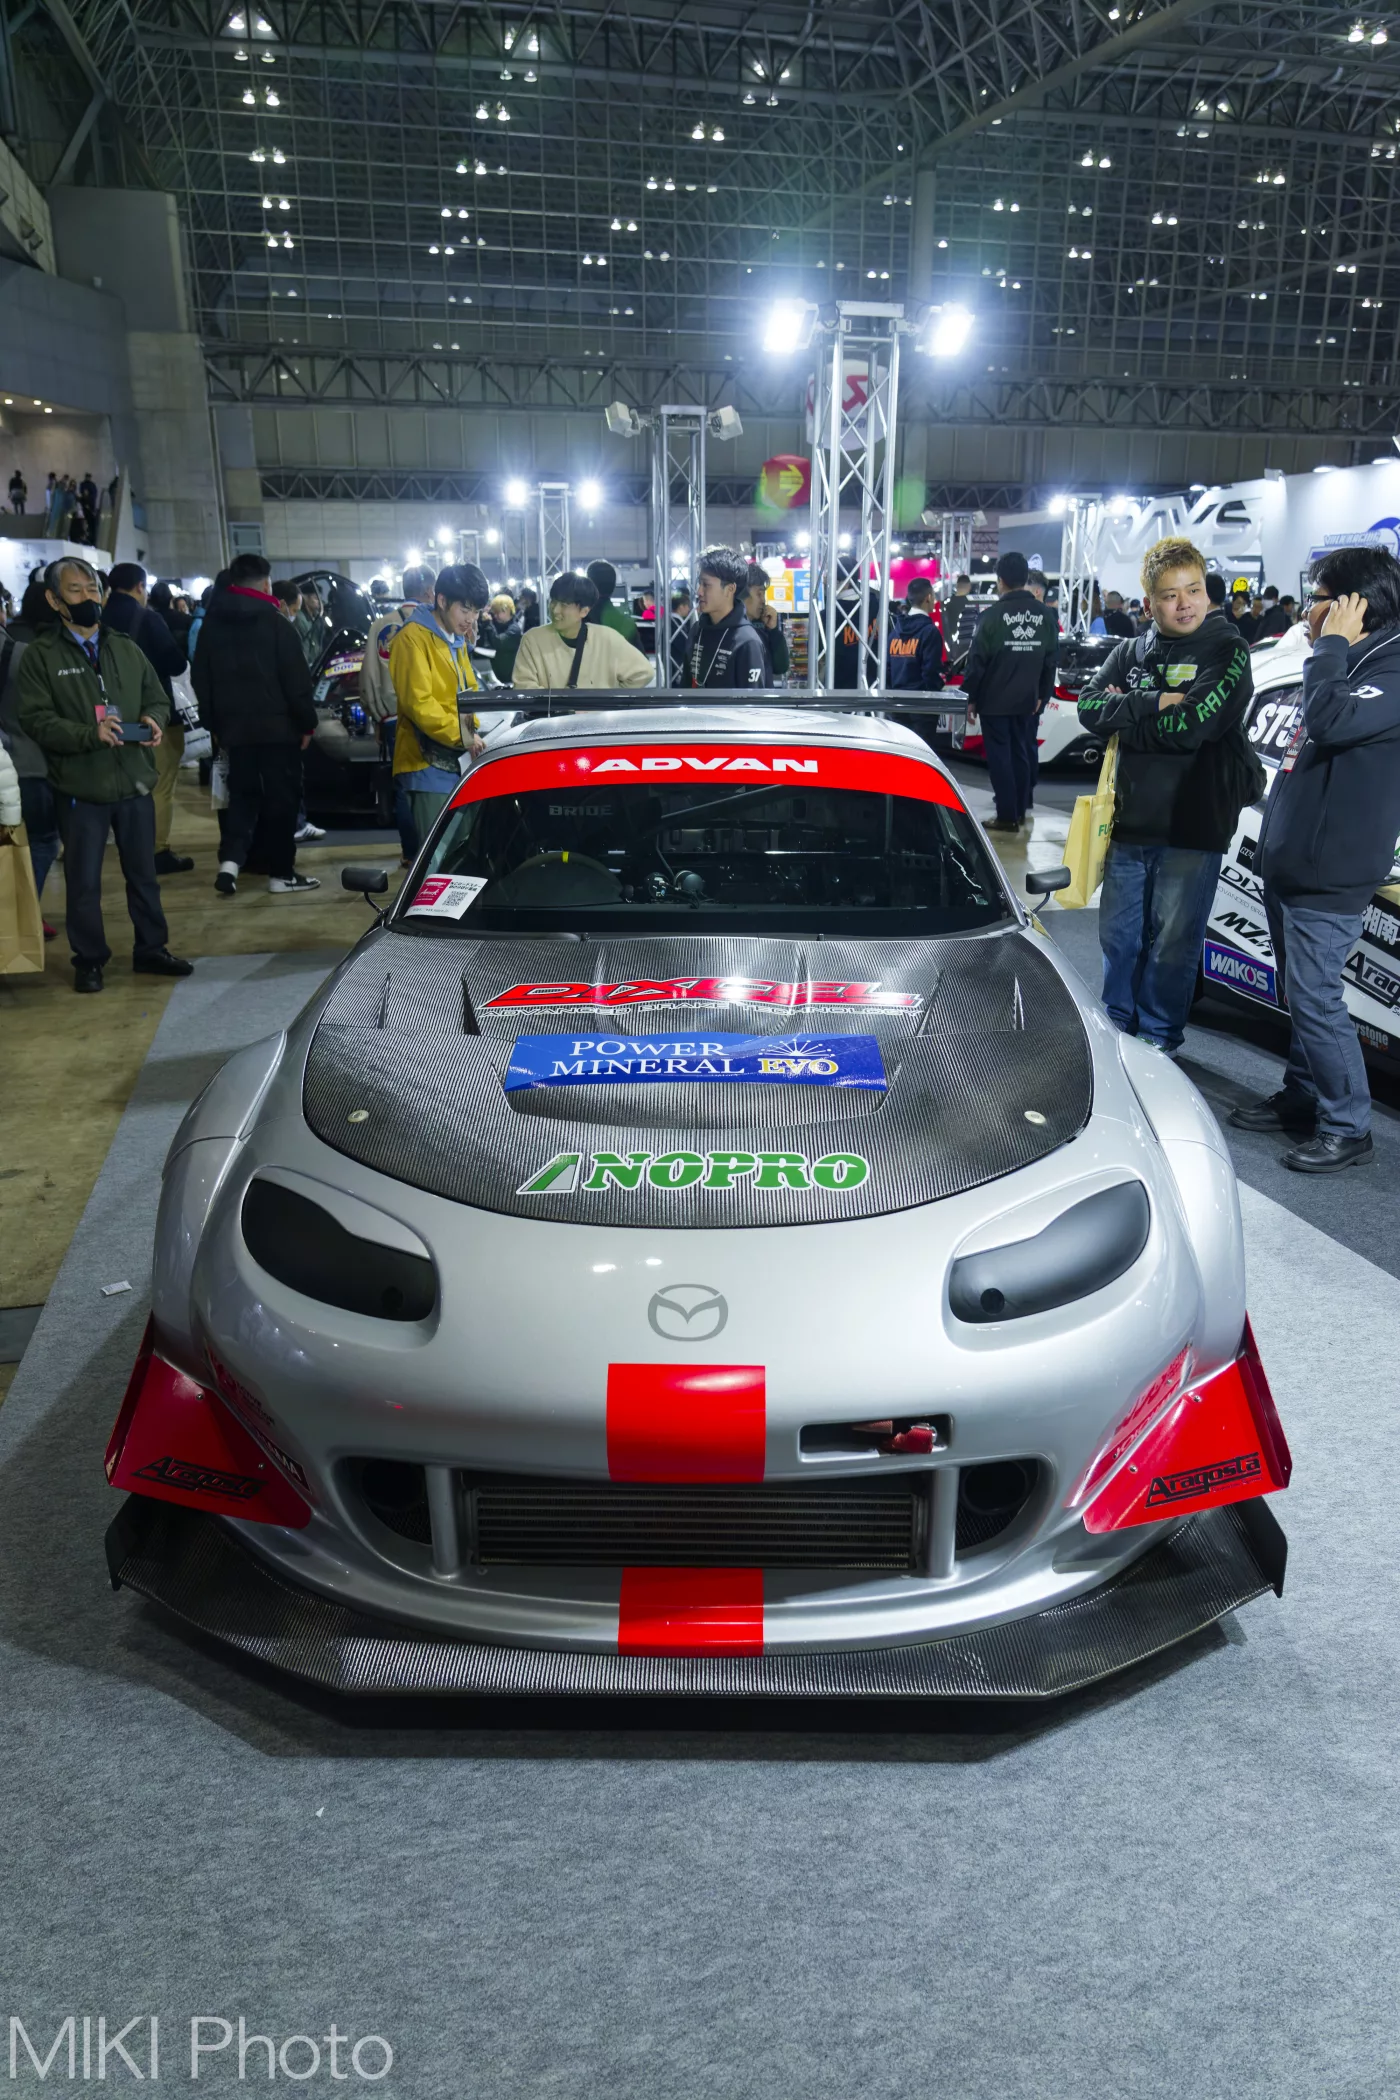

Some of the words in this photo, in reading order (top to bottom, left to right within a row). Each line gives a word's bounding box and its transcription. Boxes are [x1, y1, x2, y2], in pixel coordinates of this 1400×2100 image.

[1099, 491, 1264, 565] RAYS
[748, 668, 762, 683] 37
[1195, 647, 1248, 723] RACING
[591, 757, 819, 774] ADVAN
[549, 804, 613, 816] BRIDE
[1217, 885, 1250, 908] DVANCED
[475, 976, 925, 1010] DIXCEL
[478, 1005, 631, 1018] ADVANCED
[743, 1001, 926, 1017] TECHNOLOGY
[569, 1041, 729, 1056] POWER
[549, 1058, 745, 1077] MINERAL
[758, 1058, 839, 1076] EVO
[582, 1151, 870, 1192] NOPRO
[1144, 1452, 1262, 1508] Aragosta
